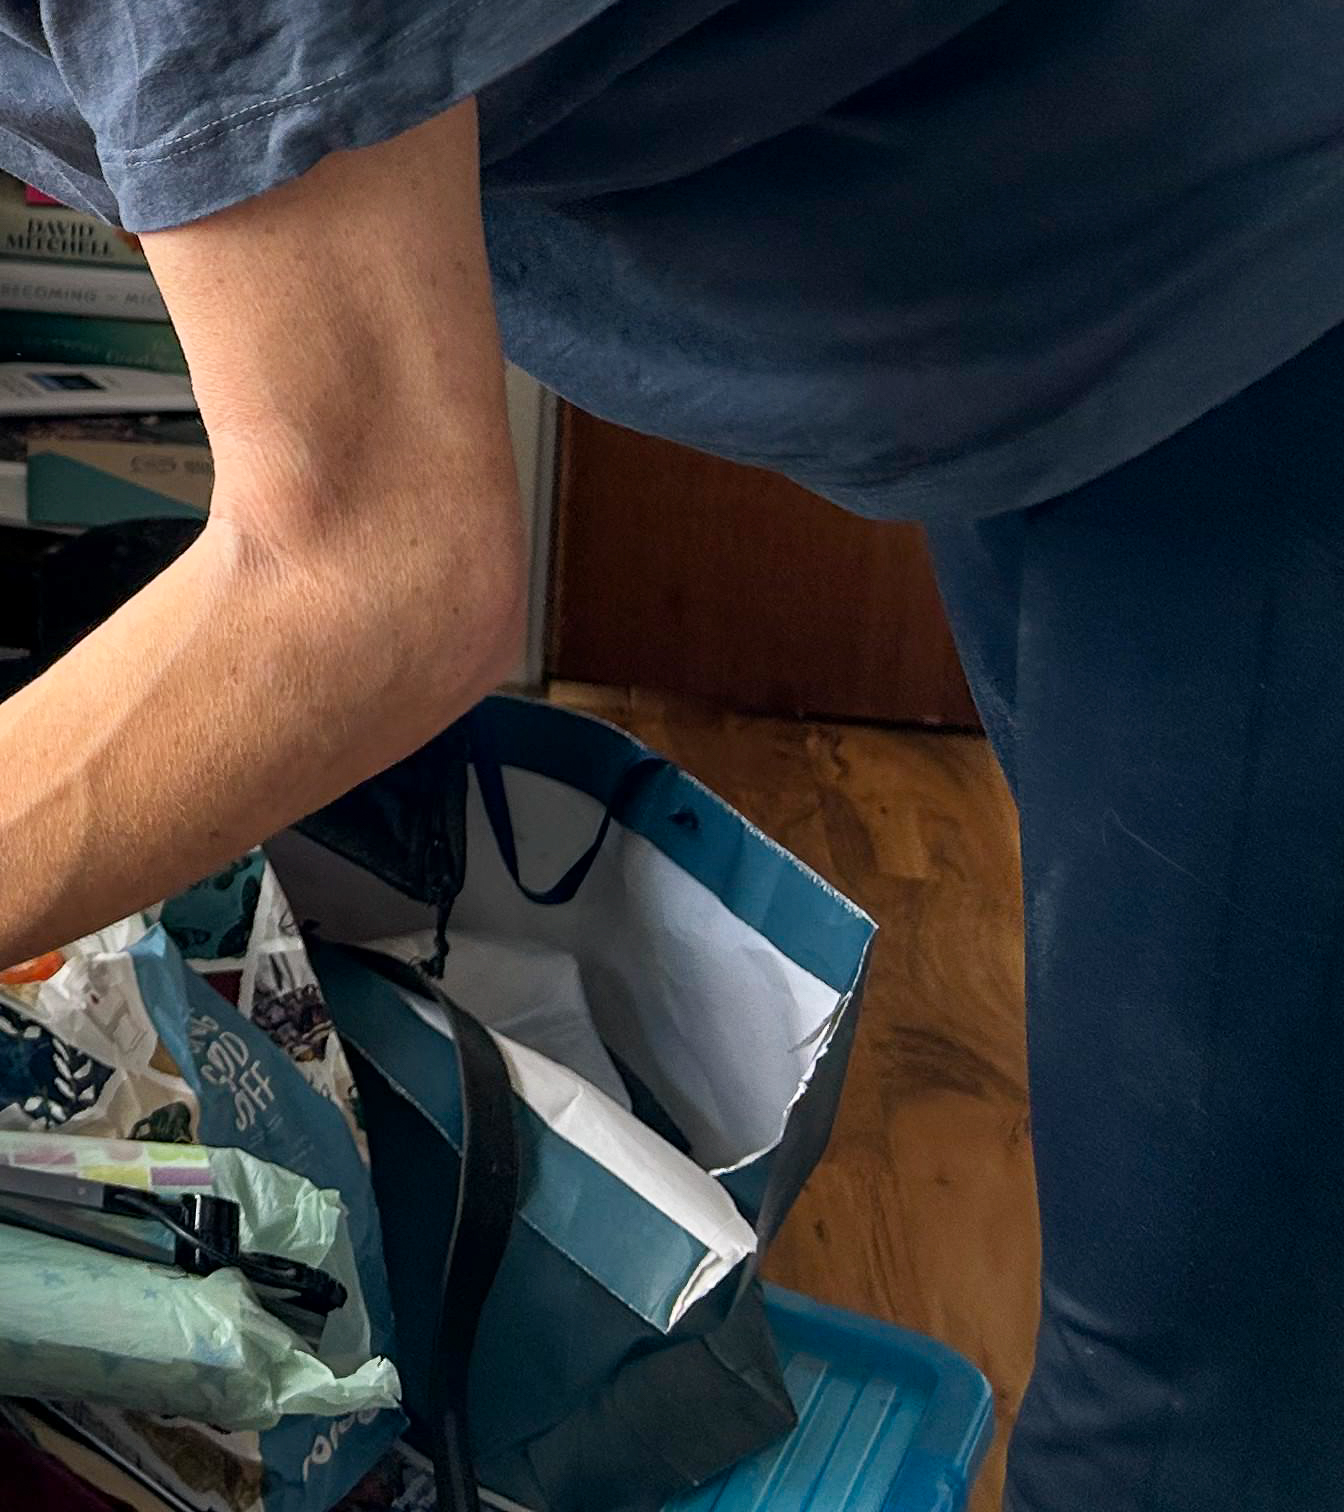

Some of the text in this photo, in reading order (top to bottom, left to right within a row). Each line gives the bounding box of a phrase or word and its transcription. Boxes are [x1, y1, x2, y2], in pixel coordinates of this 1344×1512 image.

[27, 218, 95, 236] DAVID
[5, 233, 113, 255] MITCHELL
[0, 284, 97, 303] BECOMING
